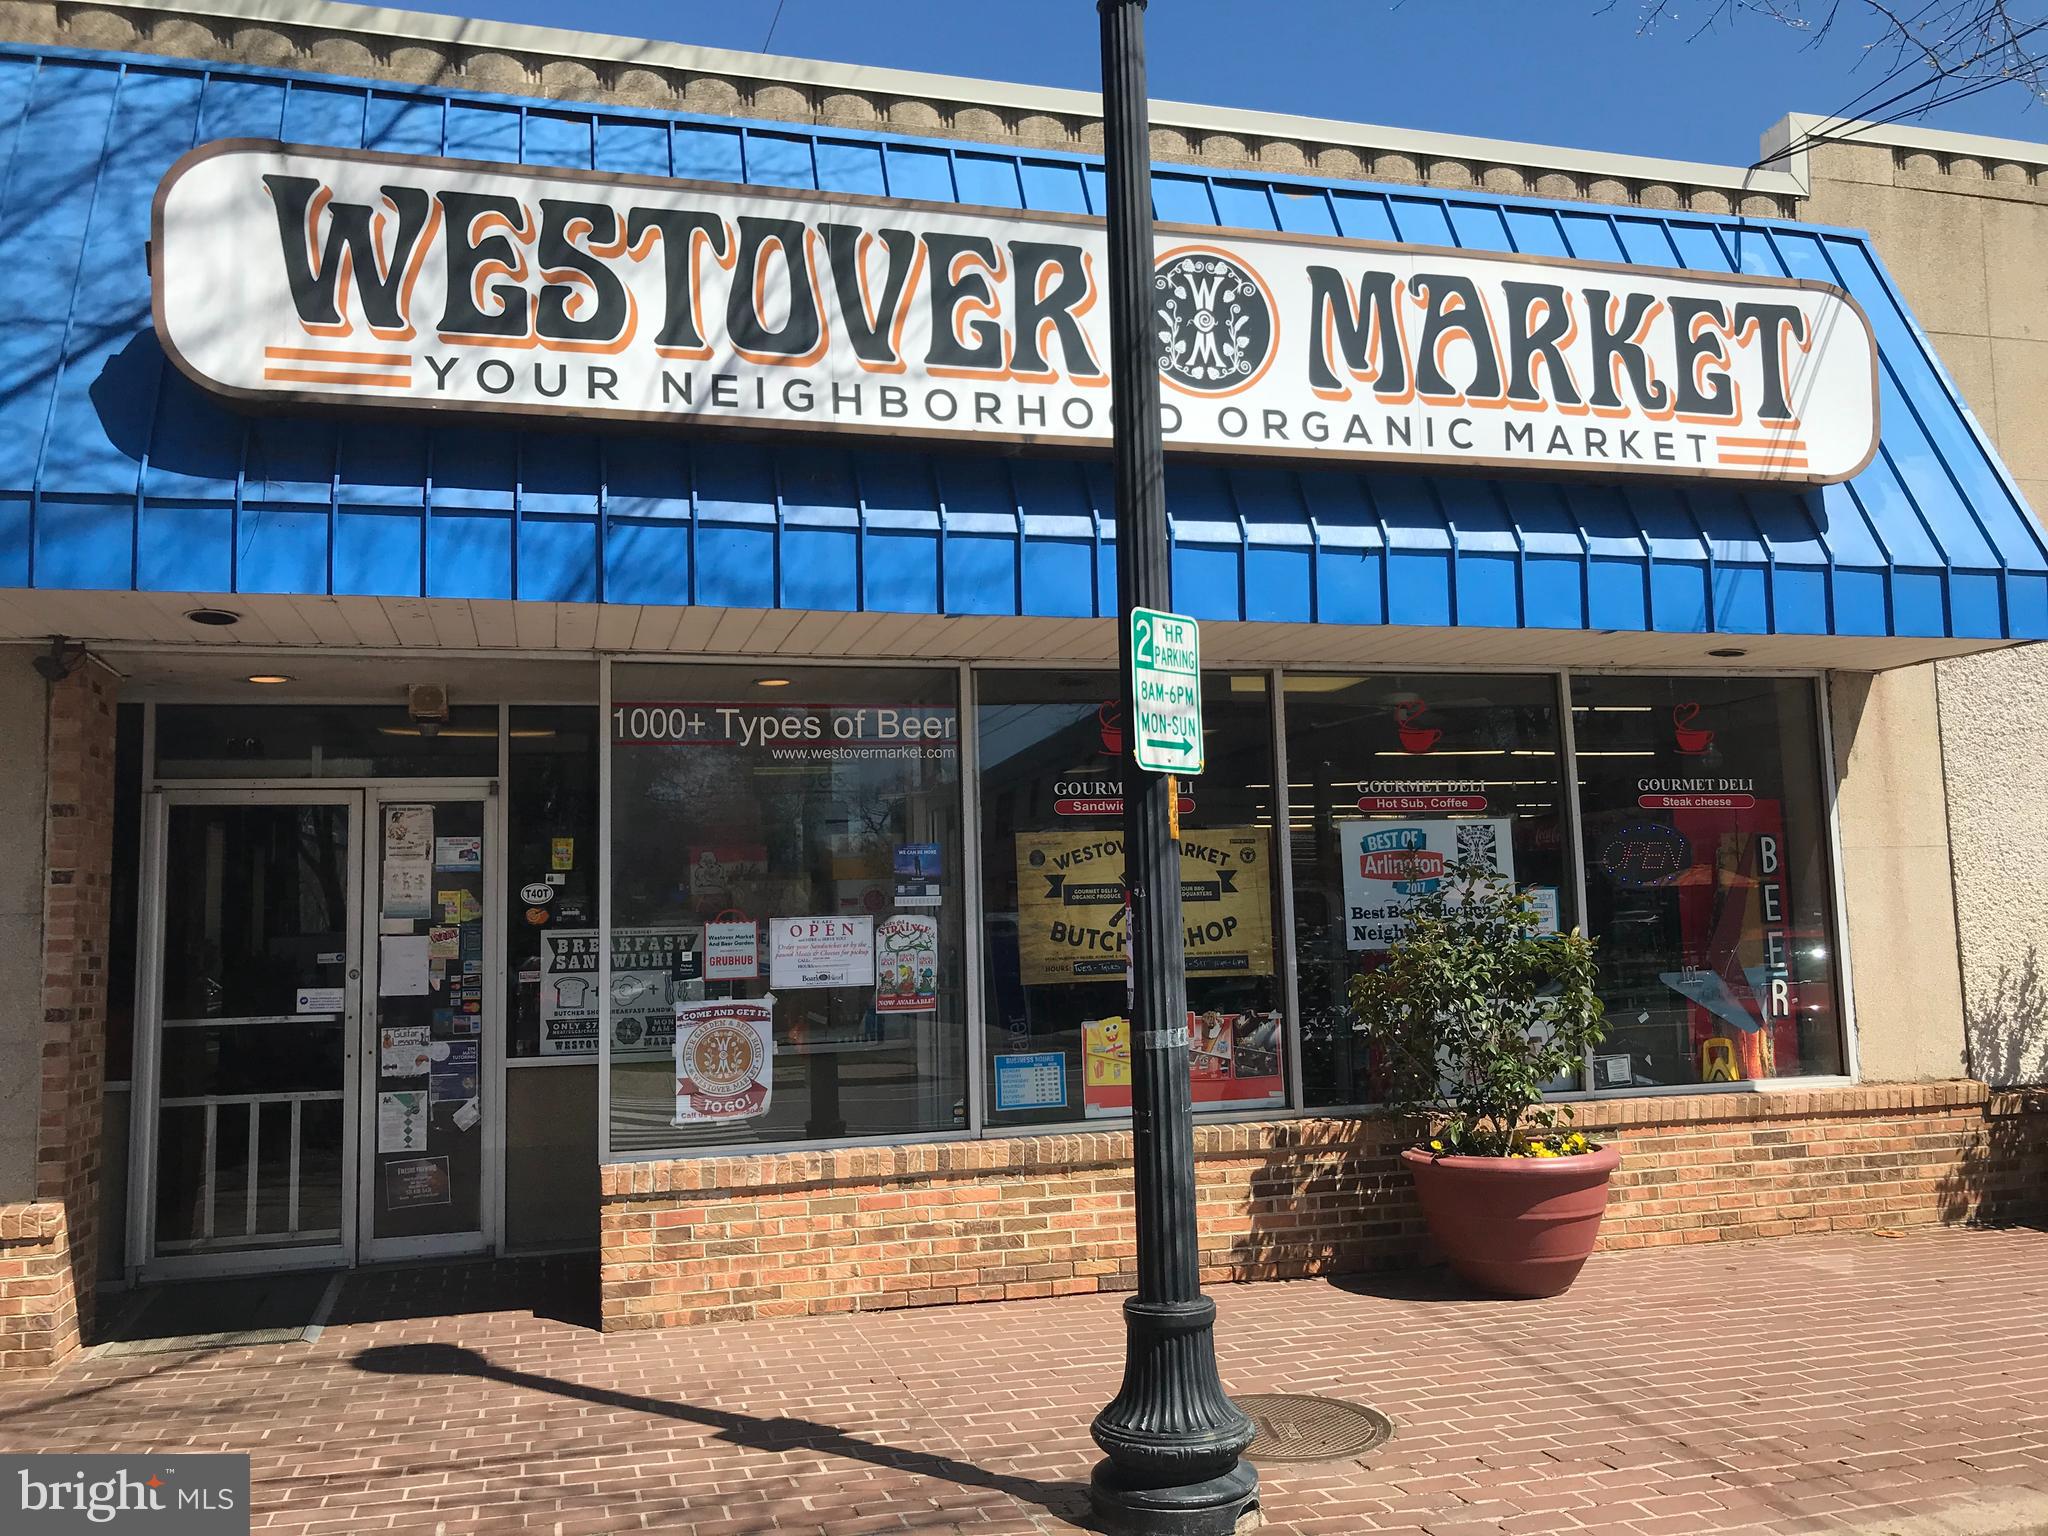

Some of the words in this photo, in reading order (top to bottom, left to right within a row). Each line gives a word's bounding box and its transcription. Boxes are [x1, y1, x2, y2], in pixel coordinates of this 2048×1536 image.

[262, 174, 1108, 386] WESTOVER
[1306, 265, 1811, 428] MARKET
[425, 356, 618, 400] YOUR
[663, 371, 1183, 434] NEIGHBORHOD
[1218, 406, 1473, 449] ORGANIC
[1505, 422, 1707, 462] MARKET
[1136, 619, 1152, 663] 2
[1165, 625, 1183, 644] HR
[1155, 646, 1194, 670] PARKING
[1141, 681, 1193, 706] 8AM-6PM
[613, 708, 705, 738] 1000+
[716, 708, 821, 746] Types
[833, 708, 866, 738] of
[878, 709, 956, 738] Beer
[1142, 712, 1195, 737] MON-SUN
[772, 746, 955, 760] www.westovermarket.com
[1054, 781, 1123, 796] GOURM
[1357, 780, 1442, 794] GOURMET
[1447, 779, 1486, 793] DELI
[1638, 779, 1714, 791] GOURMET
[1719, 778, 1753, 791] DELI
[1377, 799, 1397, 808] Hot
[1401, 799, 1427, 809] Sub,
[1431, 798, 1468, 808] Coffee
[1663, 796, 1693, 807] Steak
[1695, 796, 1731, 807] cheese
[1367, 832, 1398, 851] BEST
[1401, 831, 1418, 848] OF
[1602, 841, 1685, 870] OPEN
[1406, 882, 1426, 893] 2017
[1351, 906, 1385, 919] Best
[790, 923, 854, 937] OPEN
[1184, 916, 1238, 947] HOP
[1760, 836, 1789, 1016] BEER
[557, 936, 689, 954] BREKFAST
[709, 955, 753, 966] GRUBHUB
[683, 1010, 711, 1020] COME
[703, 1099, 722, 1112] TO
